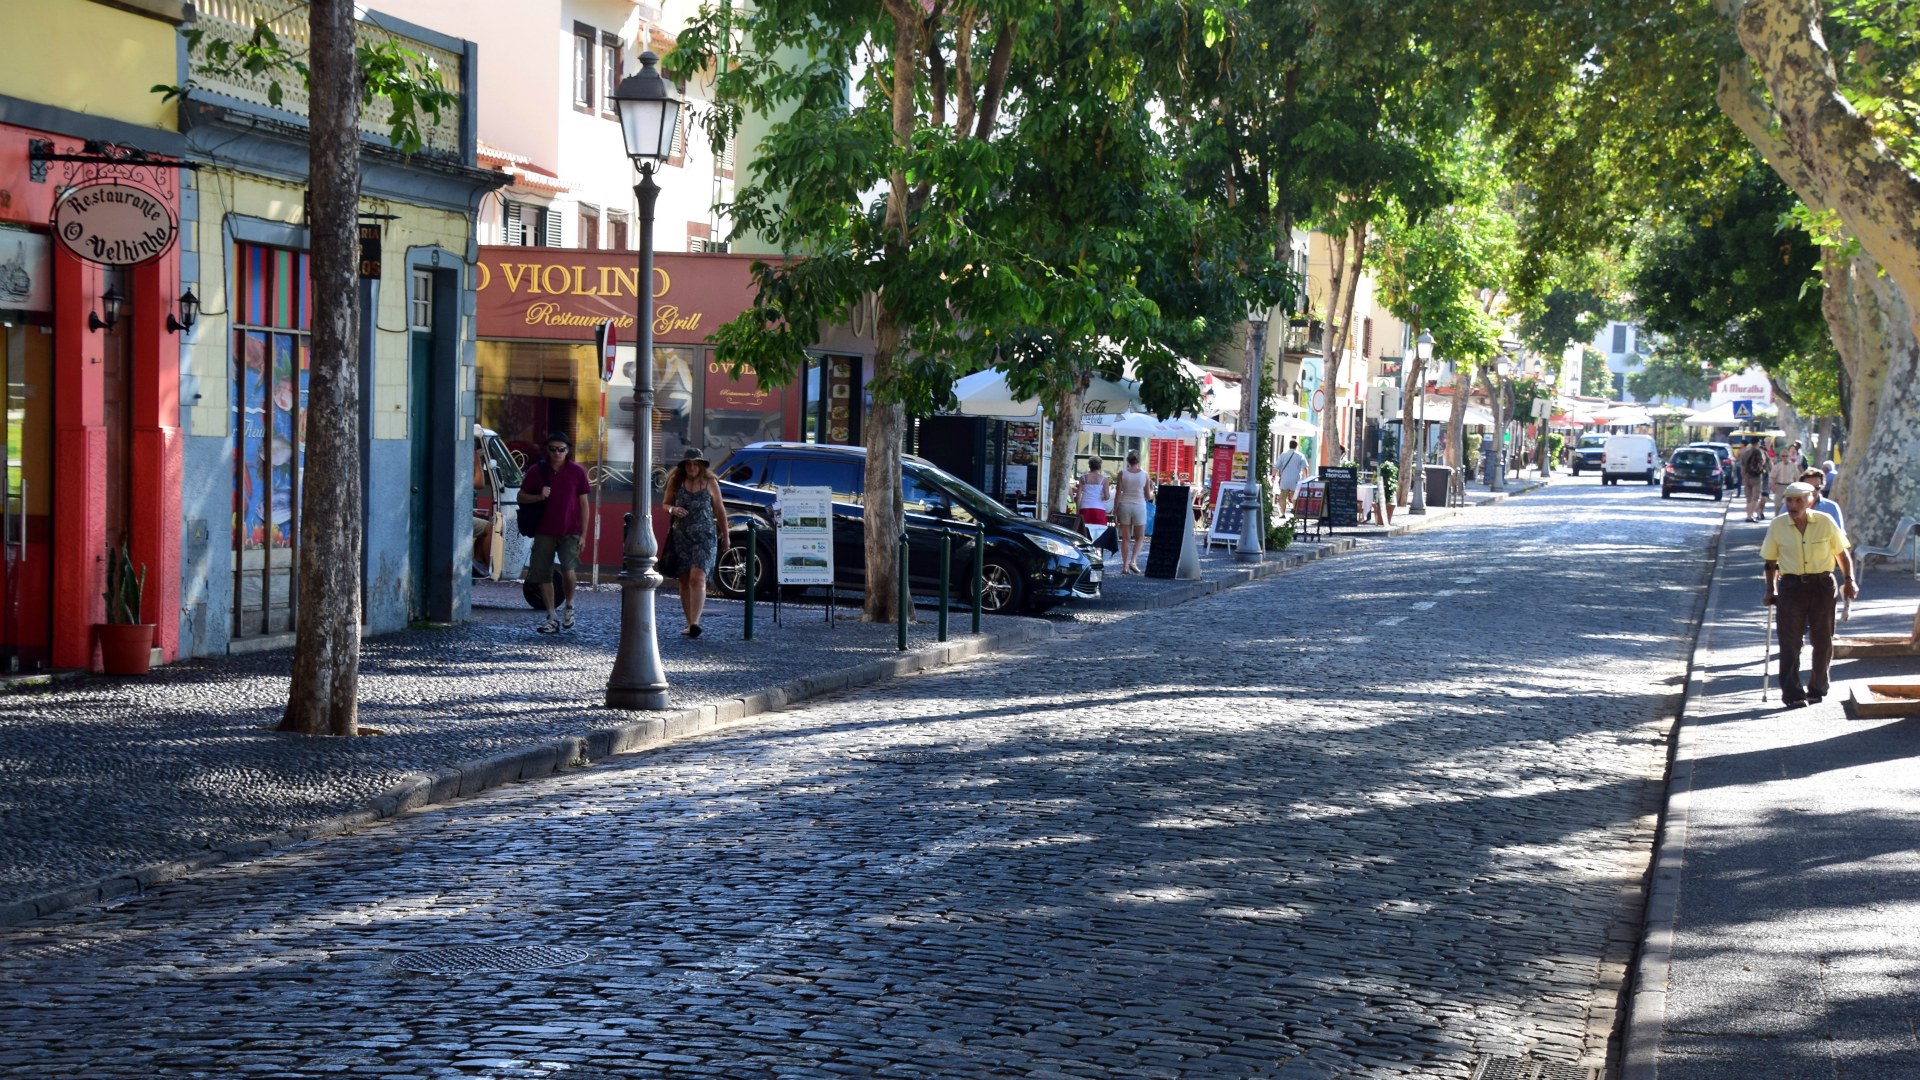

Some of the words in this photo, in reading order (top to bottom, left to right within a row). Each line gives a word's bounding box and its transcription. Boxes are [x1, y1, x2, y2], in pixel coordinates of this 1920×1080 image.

[67, 188, 160, 221] Restaurante
[64, 221, 84, 241] O
[85, 227, 167, 261] Velhinho
[500, 263, 671, 298] VIOLINO
[525, 302, 634, 329] Restaurante
[652, 304, 702, 336] Grill
[1082, 399, 1107, 414] Cola
